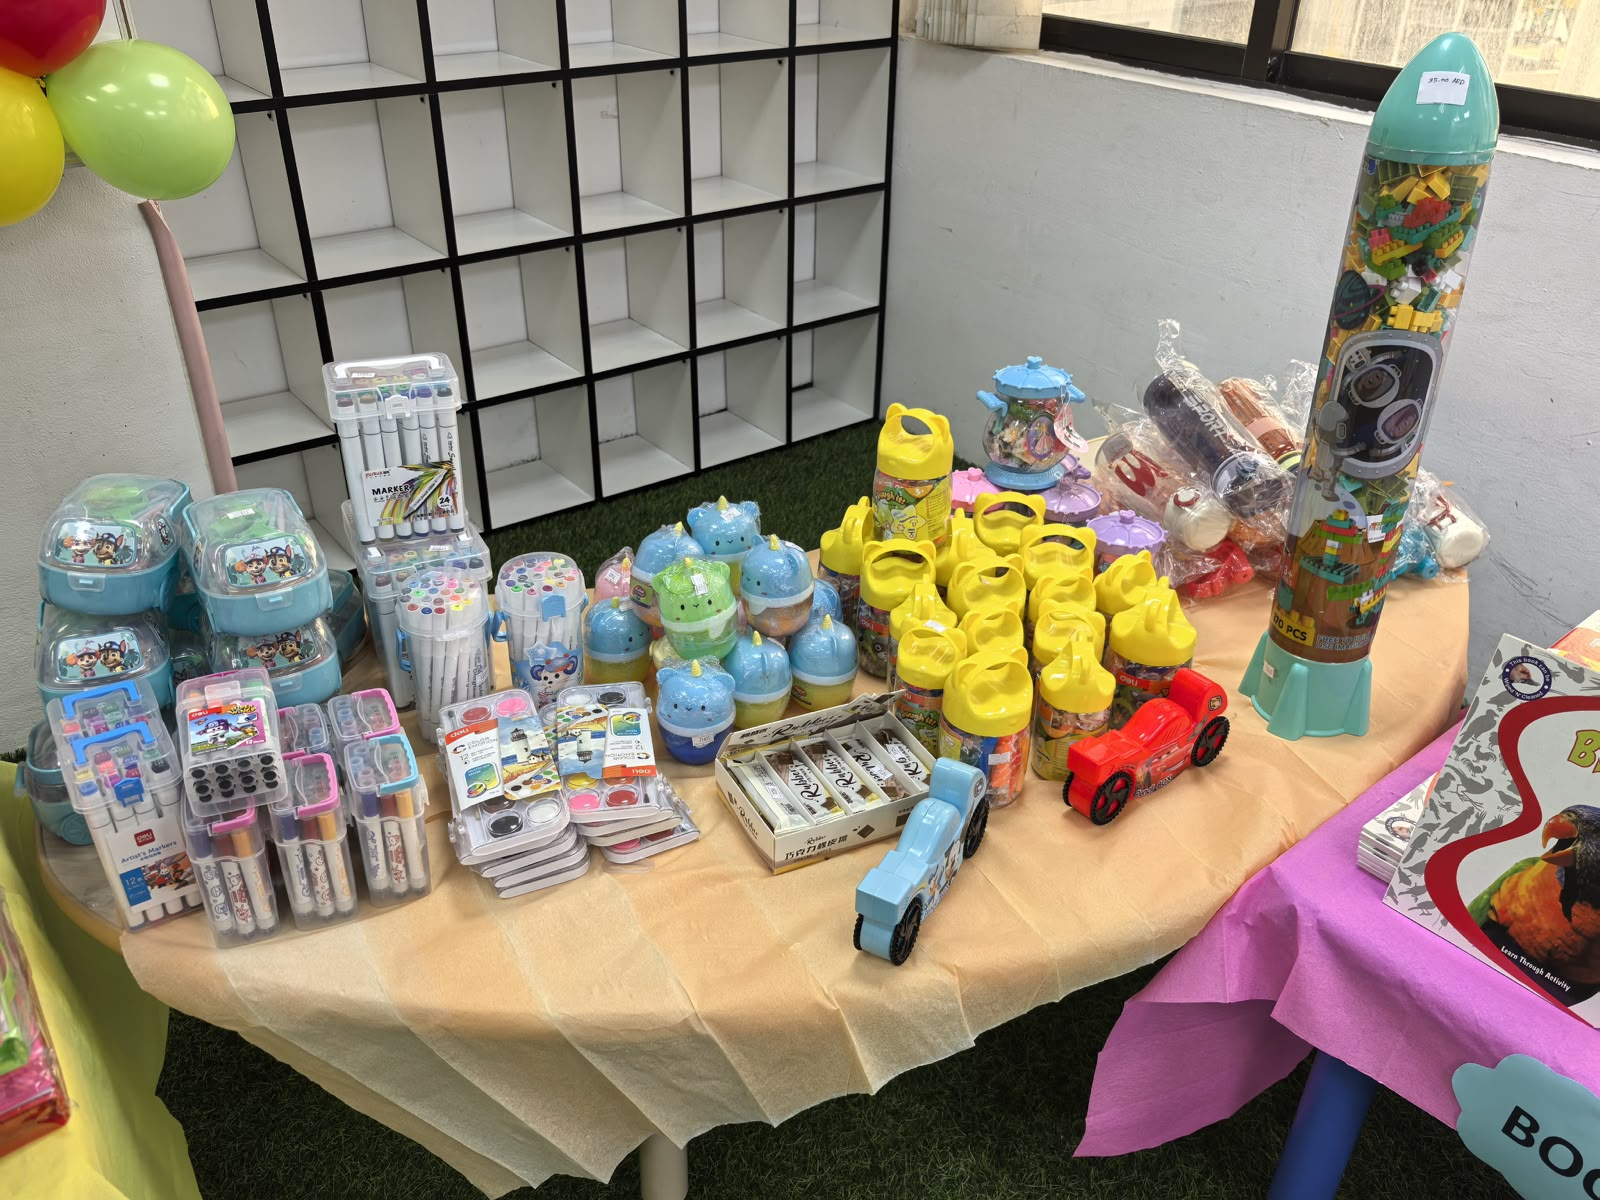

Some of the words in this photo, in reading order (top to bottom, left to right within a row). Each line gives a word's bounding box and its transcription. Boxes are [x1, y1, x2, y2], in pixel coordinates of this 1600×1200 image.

[1182, 391, 1227, 437] SPORT
[371, 484, 410, 496] MARKER
[439, 496, 450, 504] 24
[1286, 625, 1307, 641] PCS
[1509, 658, 1522, 667] This
[1523, 657, 1538, 666] book
[1538, 664, 1548, 674] can
[1545, 674, 1550, 682] be
[1120, 675, 1138, 687] deli
[1503, 677, 1514, 693] Wiped
[1521, 690, 1544, 700] Cleaned
[450, 728, 469, 738] deli
[460, 753, 469, 761] 12
[1567, 729, 1600, 773] B
[824, 754, 857, 789] Rubber
[789, 764, 822, 801] Rubber
[136, 831, 153, 841] deli
[121, 851, 147, 863] Artist's
[148, 841, 177, 854] Markers
[126, 877, 136, 886] 12
[1500, 945, 1518, 960] Learn
[1519, 956, 1544, 975] Through
[1544, 972, 1571, 992] Activity
